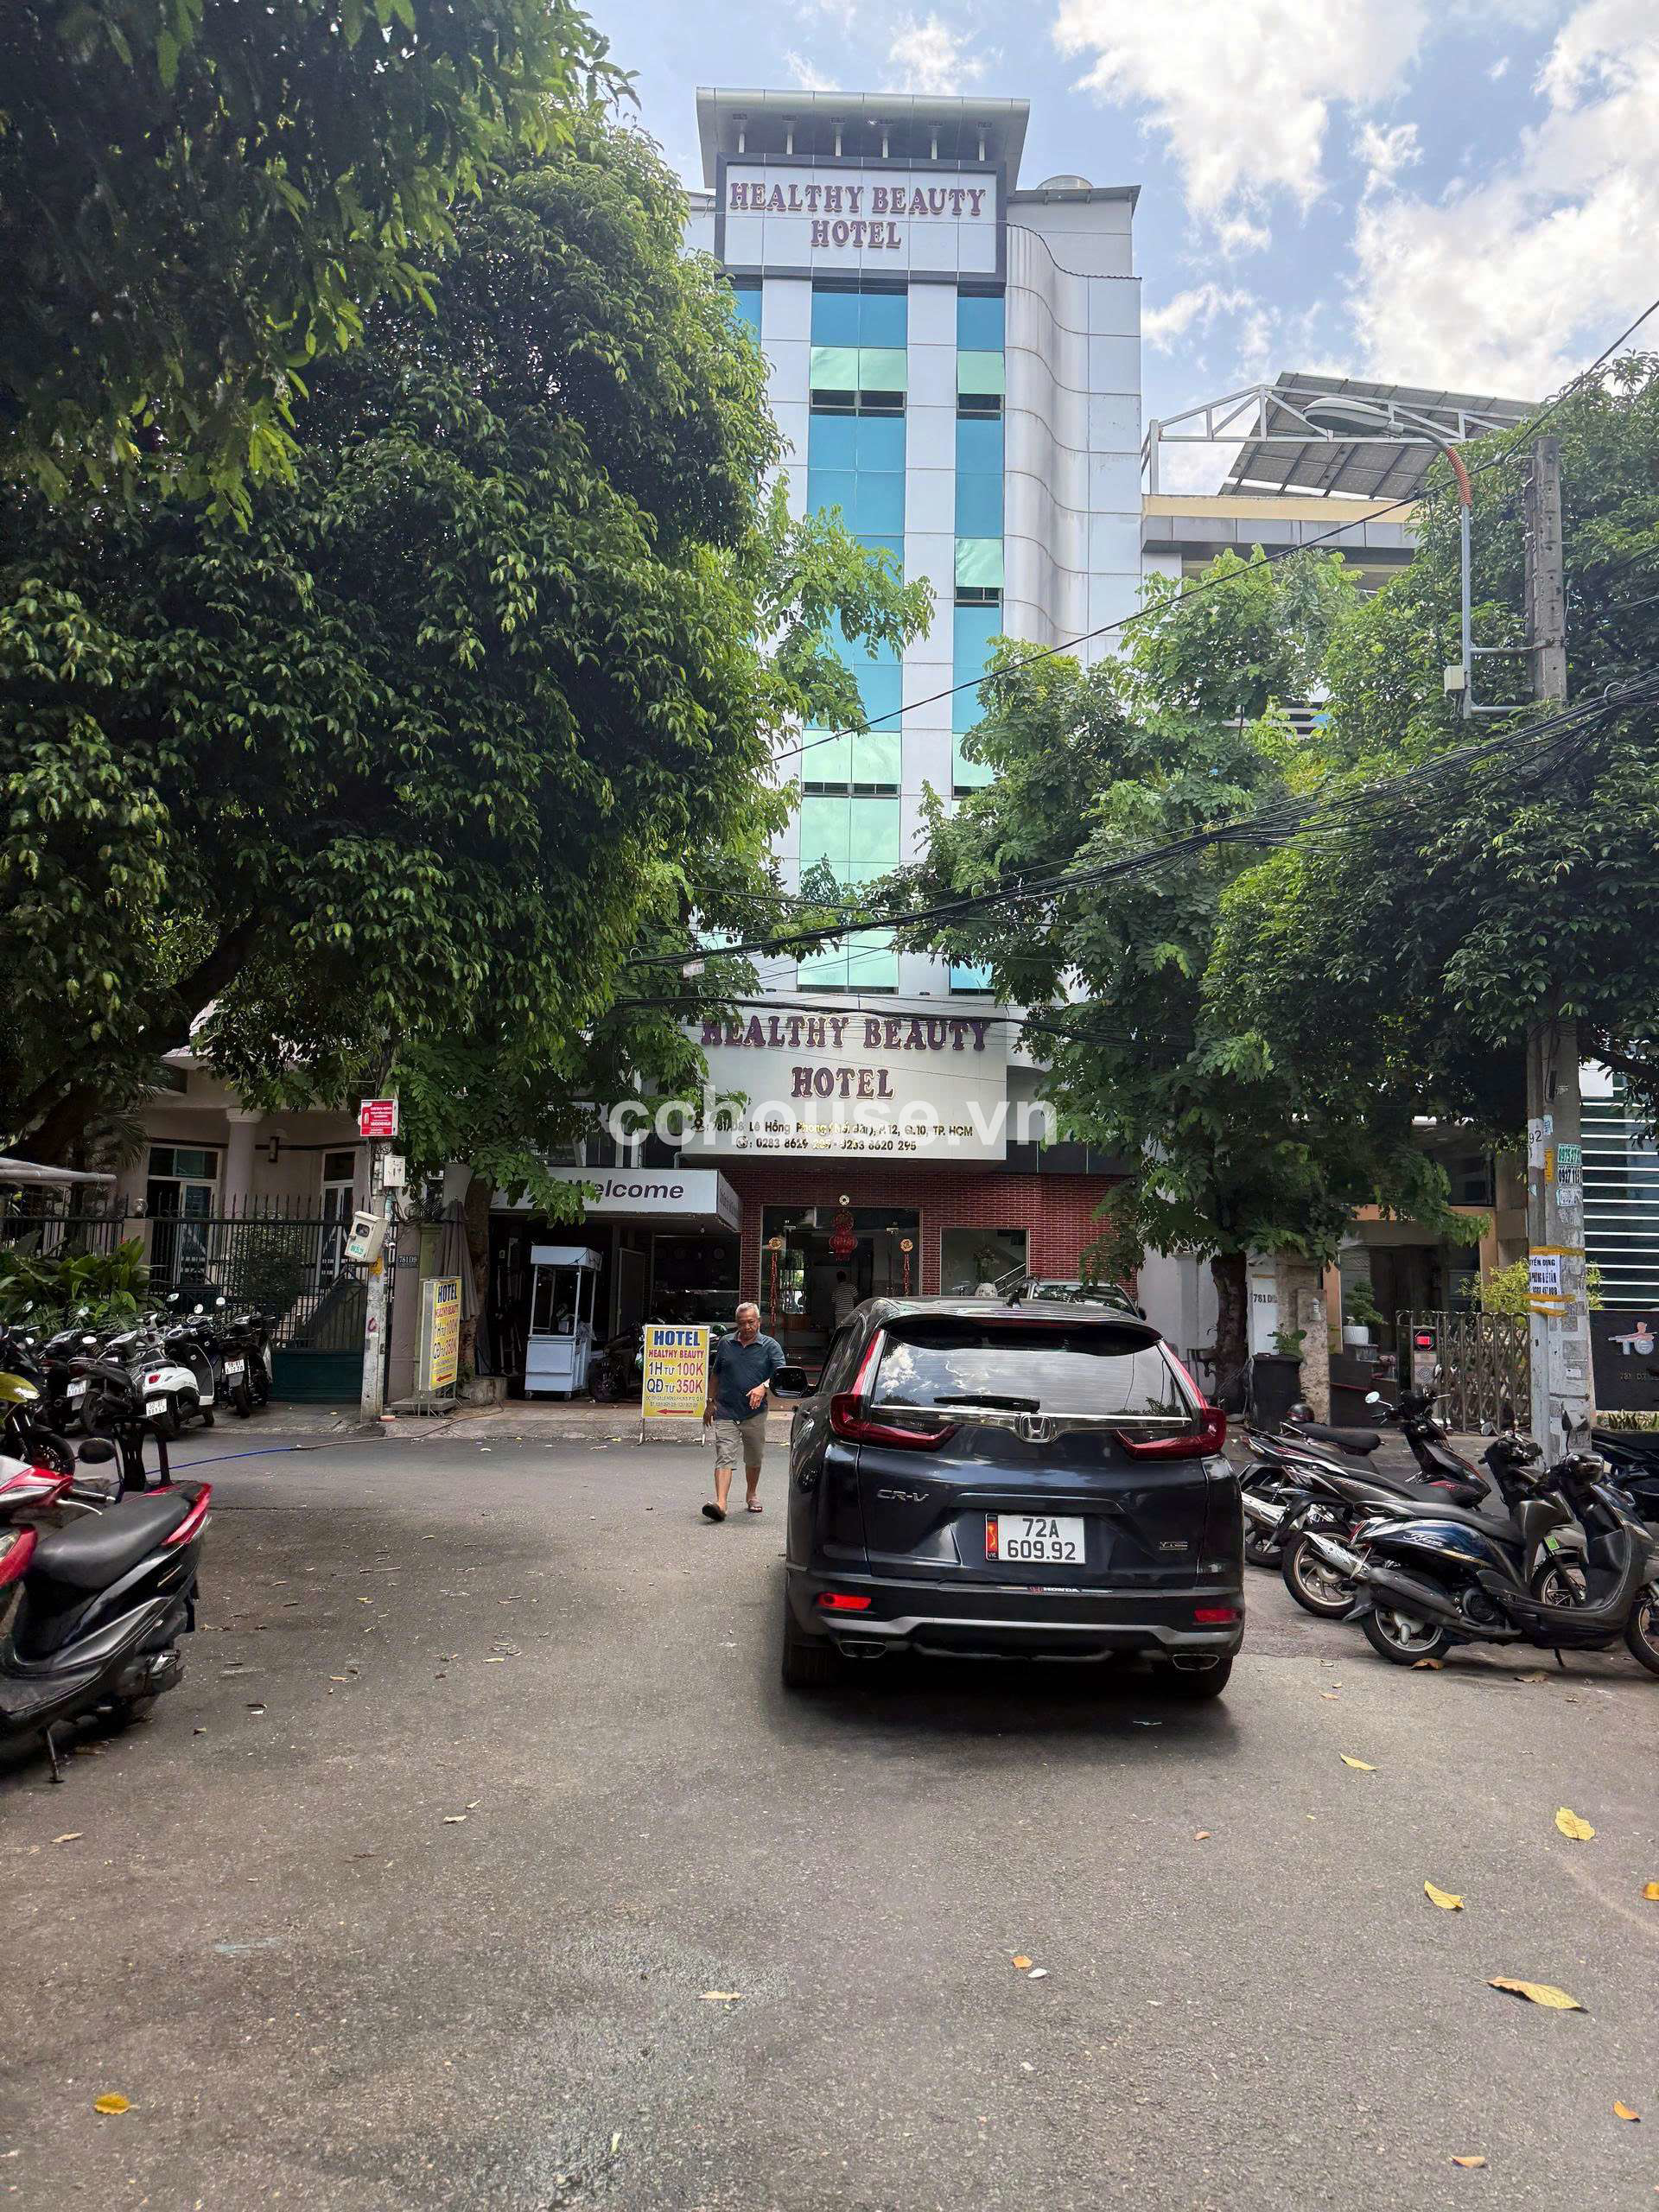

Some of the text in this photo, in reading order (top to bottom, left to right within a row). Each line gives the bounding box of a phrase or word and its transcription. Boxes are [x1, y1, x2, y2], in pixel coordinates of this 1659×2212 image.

[730, 182, 986, 216] HEALTHY BEAUTY
[810, 219, 901, 249] HOTEL
[701, 1014, 990, 1052] HEALTHY BEAUTY
[791, 1066, 895, 1100] HOTEL
[949, 1125, 973, 1136] HCM
[437, 1282, 458, 1303] HOTEL
[653, 1330, 700, 1346] HOTEL
[649, 1350, 704, 1358] HEALTHY BEAUTY
[649, 1362, 663, 1376] 1H
[677, 1362, 704, 1376] 100K
[677, 1379, 703, 1394] 350K
[877, 1489, 930, 1502] CR-V
[1022, 1517, 1060, 1538] 72A
[1007, 1539, 1076, 1560] 609.92
